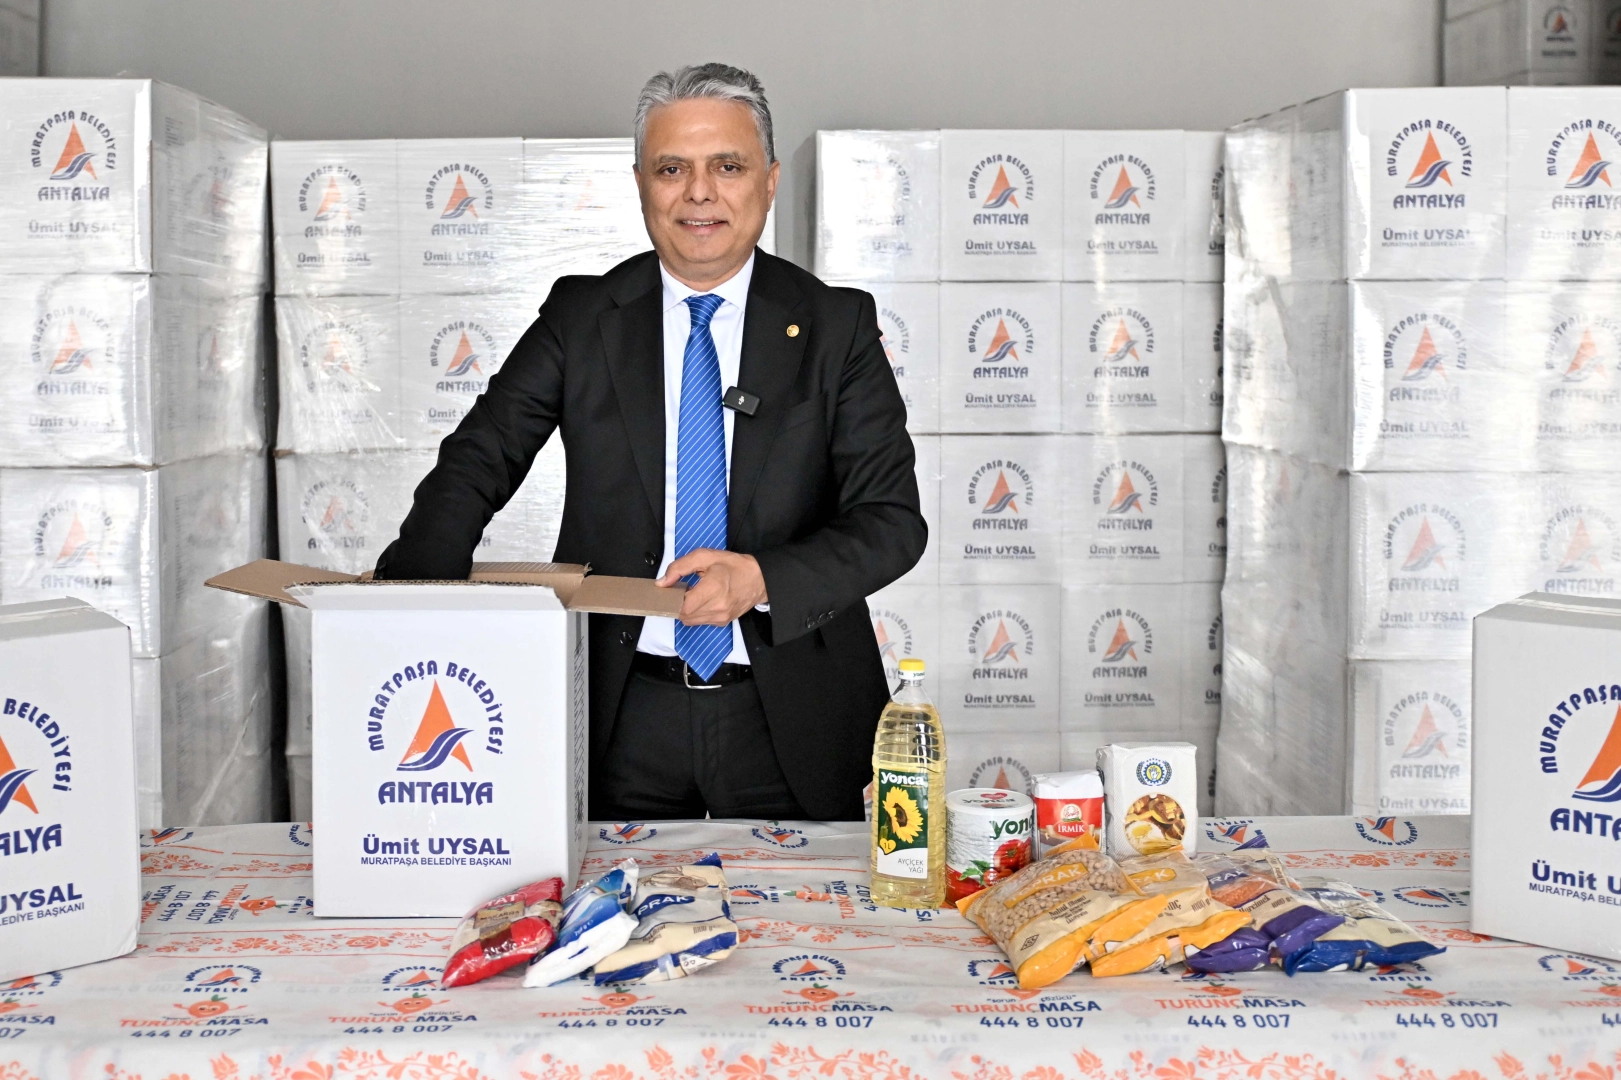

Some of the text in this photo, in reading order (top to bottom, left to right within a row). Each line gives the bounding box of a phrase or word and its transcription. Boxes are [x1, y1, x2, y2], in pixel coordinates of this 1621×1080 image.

[31, 110, 75, 168] MURATPAŞA
[1387, 119, 1472, 177] MURATPAŞA BELEDİYESİ
[1547, 119, 1592, 176] MURATPAŞA
[968, 154, 1035, 200] MURATPAŞA BELEDİYESİ
[1090, 154, 1124, 199] MURATPAŞA
[426, 163, 460, 209] MURATPAŞA
[38, 187, 110, 201] ANTALYA
[1393, 194, 1465, 209] ANTALYA
[29, 219, 119, 232] Ümit UYSAL
[973, 213, 1029, 225] ANTALYA
[1095, 213, 1150, 225] ANTALYA
[431, 223, 488, 236] ANTALYA
[1383, 227, 1470, 240] Ümit UYSA
[1582, 230, 1621, 240] UYSA
[965, 239, 1036, 250] Ümit UYSAL
[1118, 241, 1158, 250] UYSAL
[968, 308, 1034, 353] MURATPAŞA BELEDİYESİ
[430, 321, 465, 366] MURATPAŞA
[1384, 313, 1427, 369] MURATPAŞA
[973, 367, 1029, 379] ANTALYA
[1094, 366, 1149, 378] ANTALYA
[37, 380, 109, 395] ANTALYA
[965, 393, 1036, 403] Ümit UYSAL
[1117, 393, 1157, 402] UYSAL
[428, 407, 457, 418] Ümit
[1379, 419, 1415, 432] Ümit
[968, 460, 1002, 504] MURATPAŞA
[973, 518, 1028, 530] ANTALYA
[1098, 518, 1153, 531] ANTALYA
[964, 544, 1035, 554] Ümit UYSAL
[1089, 544, 1160, 555] Ümit UYSAL
[41, 574, 112, 590] ANTALYA
[1389, 577, 1459, 592] ANTALYA
[1545, 578, 1614, 593] ANTALYA
[1379, 609, 1468, 622] Ümit UYSAL
[968, 609, 1002, 654] MURATPAŞA
[1088, 608, 1122, 652] MURATPAŞA
[973, 668, 1028, 679] ANTALYA
[1092, 666, 1147, 678] ANTALYA
[964, 693, 1035, 703] Ümit UYSAL
[1085, 692, 1154, 702] Ümit UYSAL
[368, 660, 438, 752] MURATPAŞA
[446, 661, 504, 755] BELEDİYESİ
[1384, 691, 1429, 746] MURATPAŞA
[1539, 684, 1621, 774] MURATPAŞA
[3, 698, 72, 792] BELEDİYESİ
[1390, 764, 1460, 779] ANTALYA
[881, 771, 925, 786] yonca
[378, 781, 493, 806] ANTALYA
[1379, 796, 1468, 809] Ümit UYSAL
[1058, 823, 1085, 833] İRMİK
[0, 823, 62, 857] ALYA
[363, 834, 510, 855] Ümit UYSAL
[361, 856, 512, 867] MURATPAŞA BELEDİYE BAŞKANI
[897, 858, 924, 866] AYÇİÇEK
[908, 866, 924, 874] YAĞI
[1532, 859, 1597, 891] Ümit
[1529, 882, 1595, 902] MURATPAŞA
[37, 902, 85, 920] BAŞKANI
[638, 895, 690, 915] PRAK
[744, 1004, 894, 1014] TURUNÇMASA
[951, 1000, 1102, 1013] TURUNÇMASA
[1155, 999, 1306, 1009] TURUNÇMASA
[539, 1007, 687, 1018] TURUNÇMASA
[328, 1015, 478, 1024] TURUNÇMASA
[558, 1018, 665, 1029] 444 8 007
[768, 1016, 874, 1028] 444 8 007
[980, 1016, 1084, 1028] 444 8 007
[1187, 1014, 1291, 1028] 444 8 007
[1396, 1013, 1499, 1028] 444 8 007
[1602, 1013, 1621, 1028] 44
[0, 1028, 26, 1039] 07
[131, 1030, 171, 1038] 444
[200, 1028, 242, 1038] 007
[343, 1025, 453, 1034] 444 8 007
